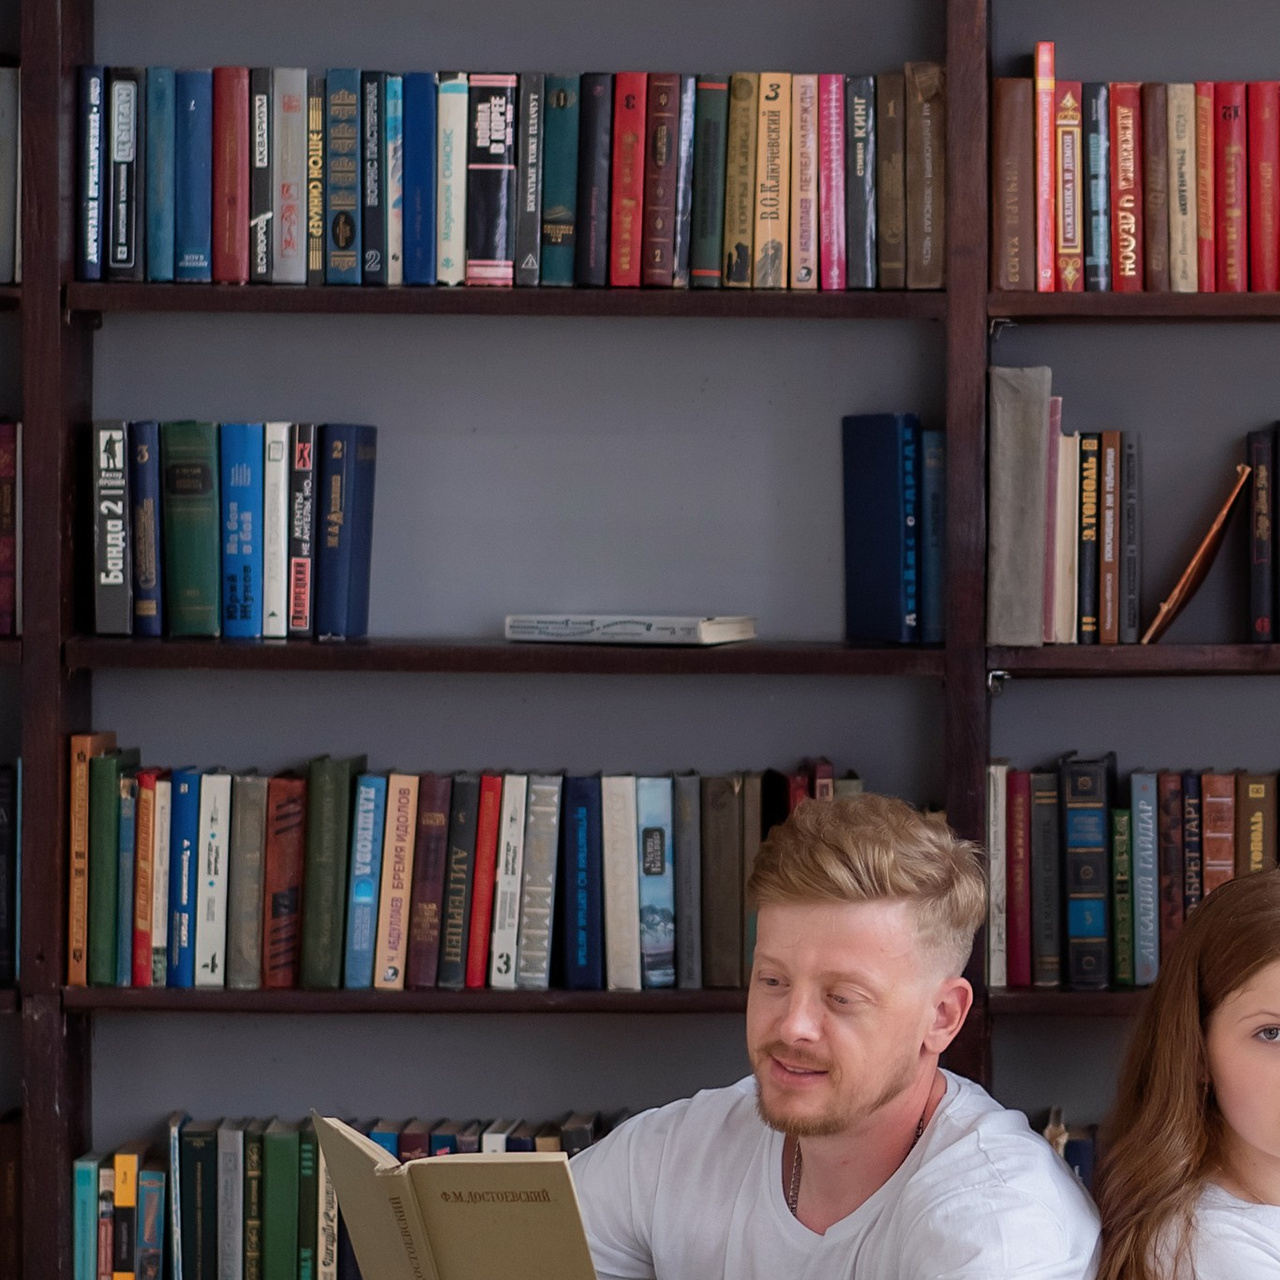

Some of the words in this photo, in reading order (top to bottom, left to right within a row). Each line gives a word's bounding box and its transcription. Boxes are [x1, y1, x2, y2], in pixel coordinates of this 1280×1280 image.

[256, 96, 267, 164] АКВАРИУМ
[366, 82, 378, 160] ПАСТЕРНАК
[475, 103, 490, 148] ВОЙНА
[490, 96, 506, 140] КОРЕЕ
[529, 93, 538, 133] ПЛАЧУТ
[854, 96, 867, 138] КИНГ
[309, 132, 323, 177] ЭПТОН
[490, 144, 505, 154] В
[528, 136, 538, 163] ТОЖЕ
[760, 110, 781, 222] В.О.Ключевский
[799, 149, 812, 192] ПЕПЕЛ
[856, 142, 864, 177] СТИВЕН
[1064, 134, 1073, 168] ДЕМОН
[367, 162, 378, 207] БОРИС
[526, 166, 537, 213] БОГАТЫЕ
[1065, 172, 1074, 181] И
[310, 181, 324, 236] СИНКЛЕР
[1104, 447, 1115, 490] ГЕЙДРИХА
[100, 499, 125, 514] 2
[292, 492, 305, 538] МЕНТЫ
[1081, 456, 1098, 541] Э.ТОПОЛЬ
[1104, 494, 1114, 504] НА
[99, 518, 126, 585] Банда
[301, 541, 311, 555] НЕ
[1104, 508, 1114, 562] ПОКУШЕНИЕ
[225, 573, 240, 620] Юрий
[239, 565, 254, 620] Жуков
[353, 786, 376, 876] ДАШКОВА
[393, 787, 411, 842] ИДОЛОВ
[1136, 799, 1155, 869] ГАЙДАР
[1184, 795, 1200, 842] ГАРТ
[391, 845, 407, 890] БРЕМЯ
[1184, 847, 1202, 896] БРЕТ
[387, 896, 404, 951] АБДУЛЛАЕВ
[444, 845, 468, 963] А.И.ГЕРЦЕН
[388, 954, 400, 962] Ч.
[440, 1187, 552, 1205] Ф.М.ДОСТОЕВСКИЙ
